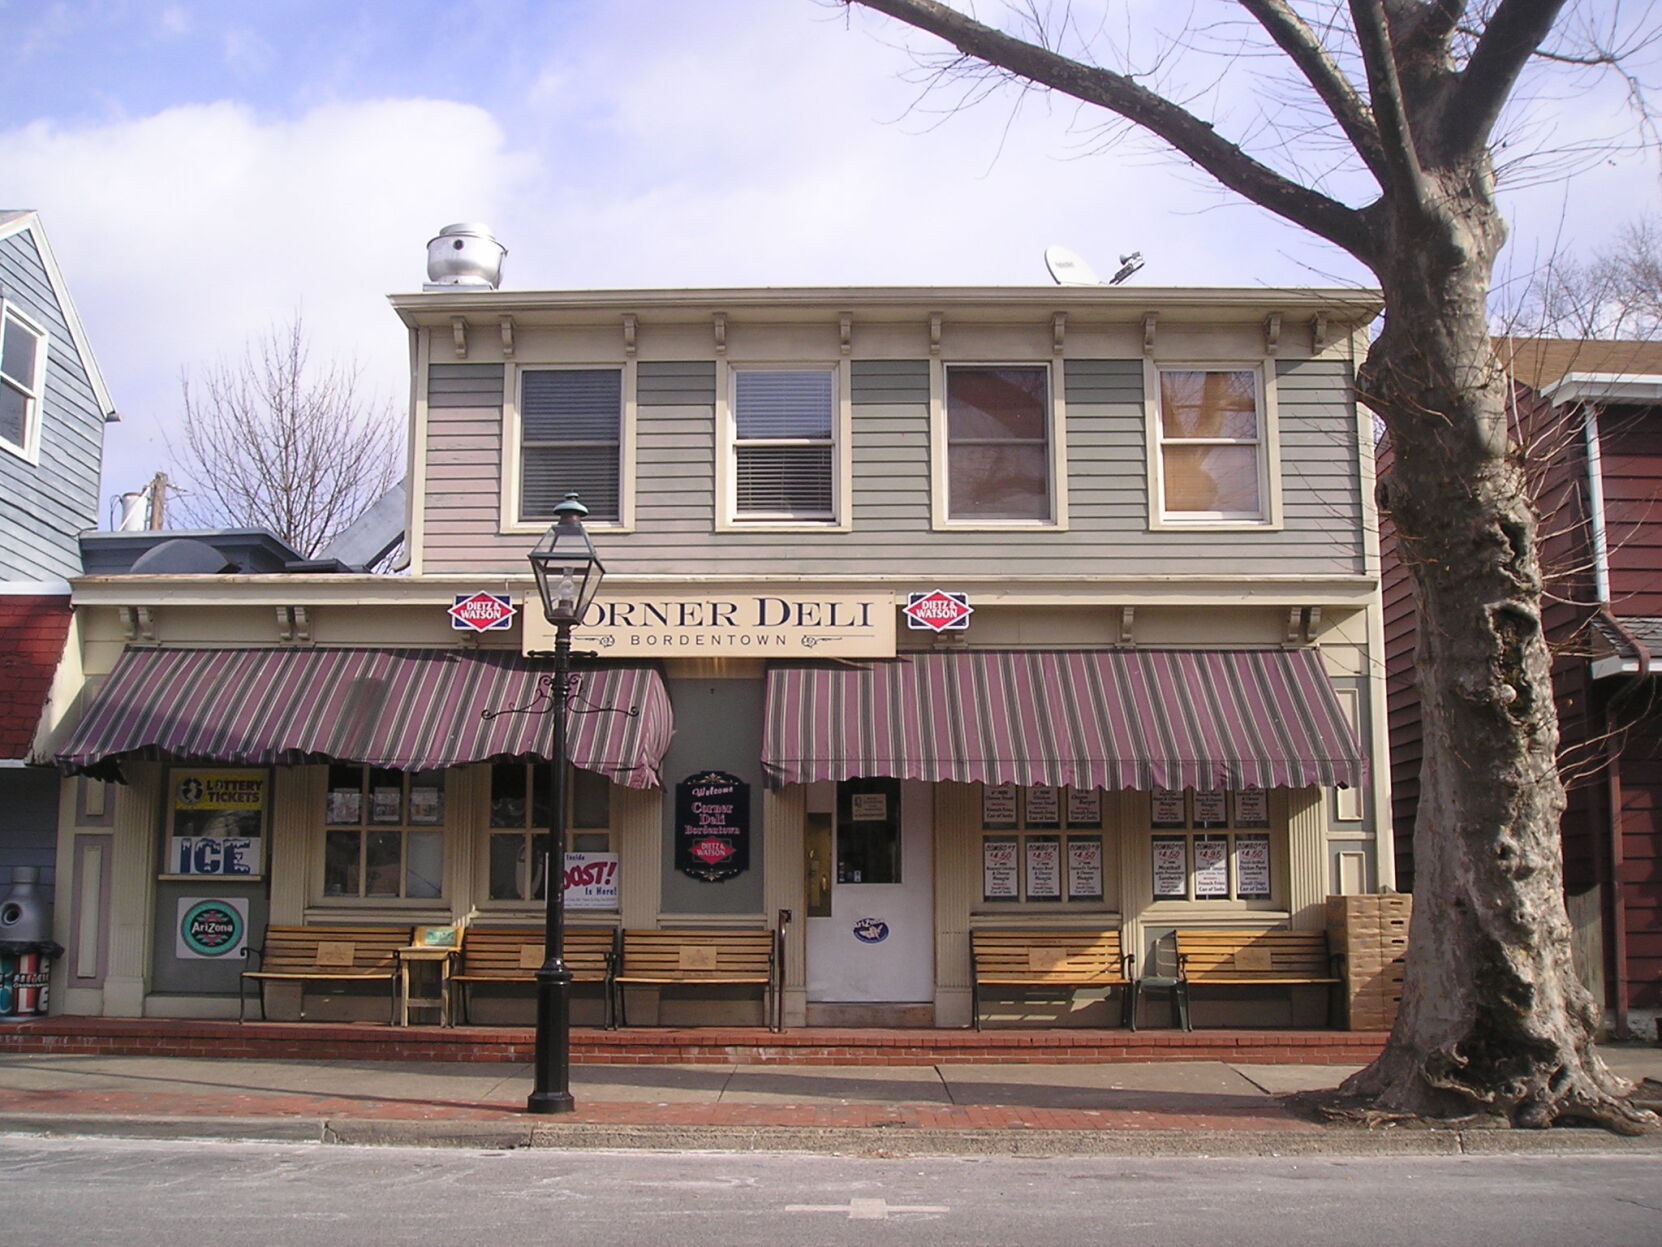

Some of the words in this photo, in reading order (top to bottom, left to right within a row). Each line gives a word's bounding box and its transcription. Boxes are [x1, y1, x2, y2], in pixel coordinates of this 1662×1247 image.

[467, 601, 492, 610] DIETZ
[493, 602, 501, 610] &
[921, 600, 948, 610] DIETZ
[949, 601, 958, 609] &
[460, 610, 502, 619] WATSON
[581, 602, 740, 628] ORNER
[753, 597, 876, 628] DELI
[916, 609, 957, 618] WATSON
[631, 634, 787, 646] BORDENTOWN
[207, 780, 263, 791] LOTTERY
[691, 786, 733, 797] Welcome
[208, 792, 260, 803] TICKETS
[690, 802, 734, 813] Corner
[699, 814, 726, 825] Deli
[684, 825, 741, 835] Bordentown
[700, 842, 718, 850] DIETZ
[180, 837, 251, 874] ICE
[696, 848, 726, 857] WATSON
[563, 861, 618, 890] OOST!
[585, 887, 593, 896] Is
[596, 887, 617, 896] Here!
[191, 921, 233, 934] AriZona
